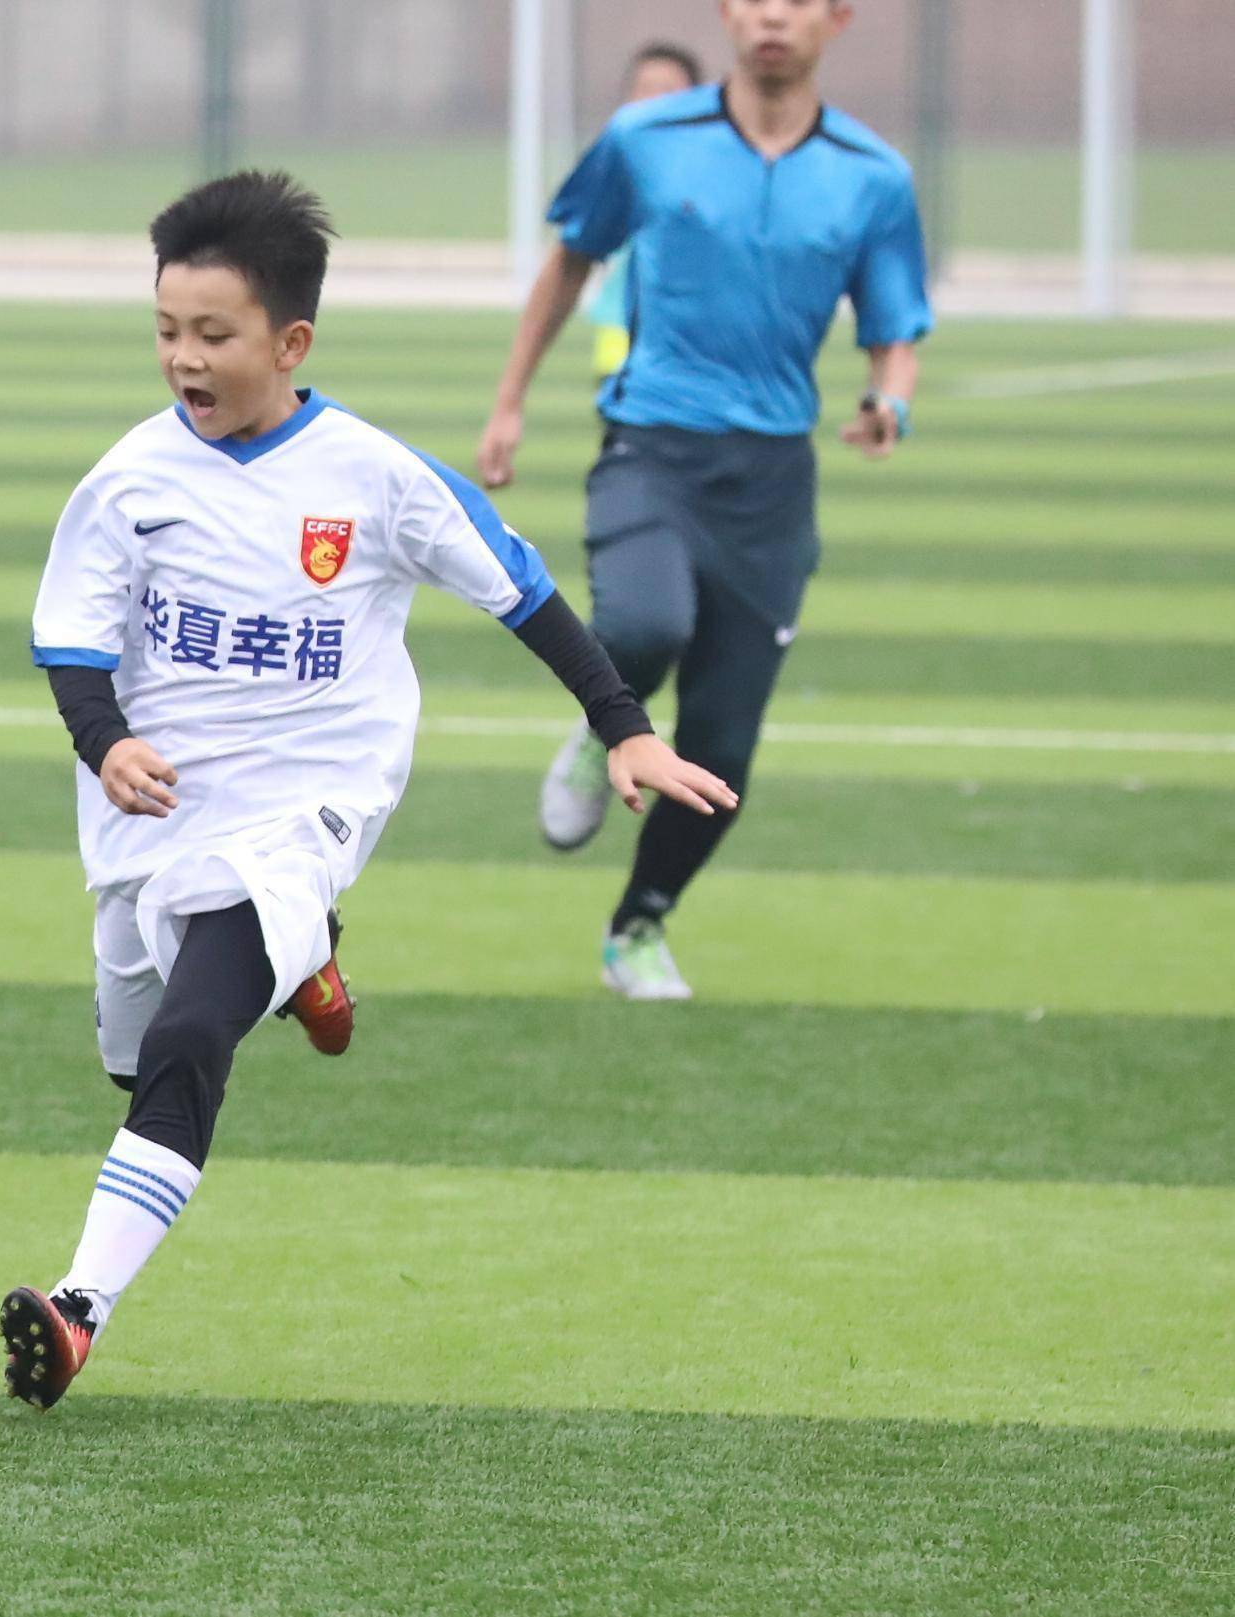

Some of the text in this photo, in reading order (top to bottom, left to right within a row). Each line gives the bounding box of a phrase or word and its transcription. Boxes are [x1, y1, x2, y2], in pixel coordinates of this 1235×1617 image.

[306, 520, 349, 537] CFFC
[140, 584, 346, 681] 华夏幸福
